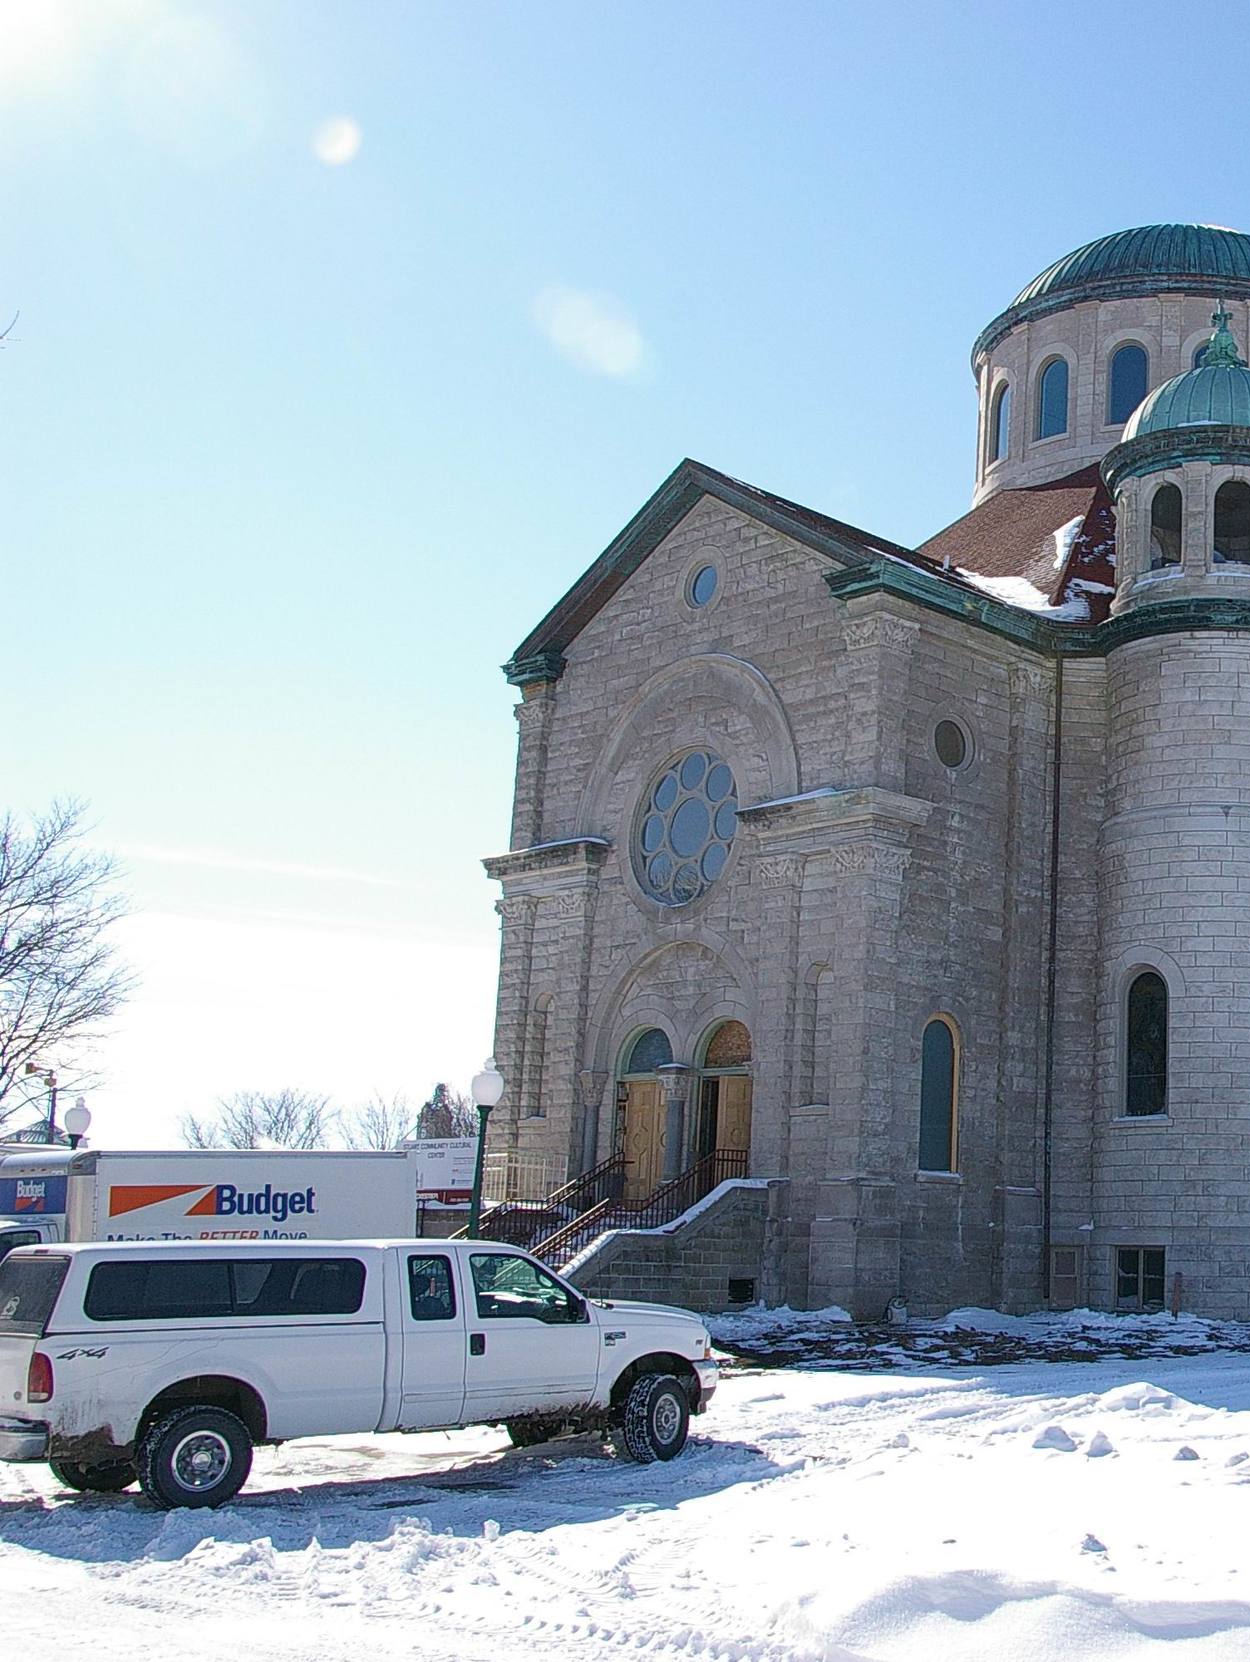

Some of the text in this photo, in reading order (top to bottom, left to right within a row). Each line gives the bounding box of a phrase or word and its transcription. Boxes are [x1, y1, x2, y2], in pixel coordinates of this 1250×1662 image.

[17, 1180, 46, 1202] Budget
[215, 1184, 316, 1222] Budget
[263, 1229, 307, 1240] Move
